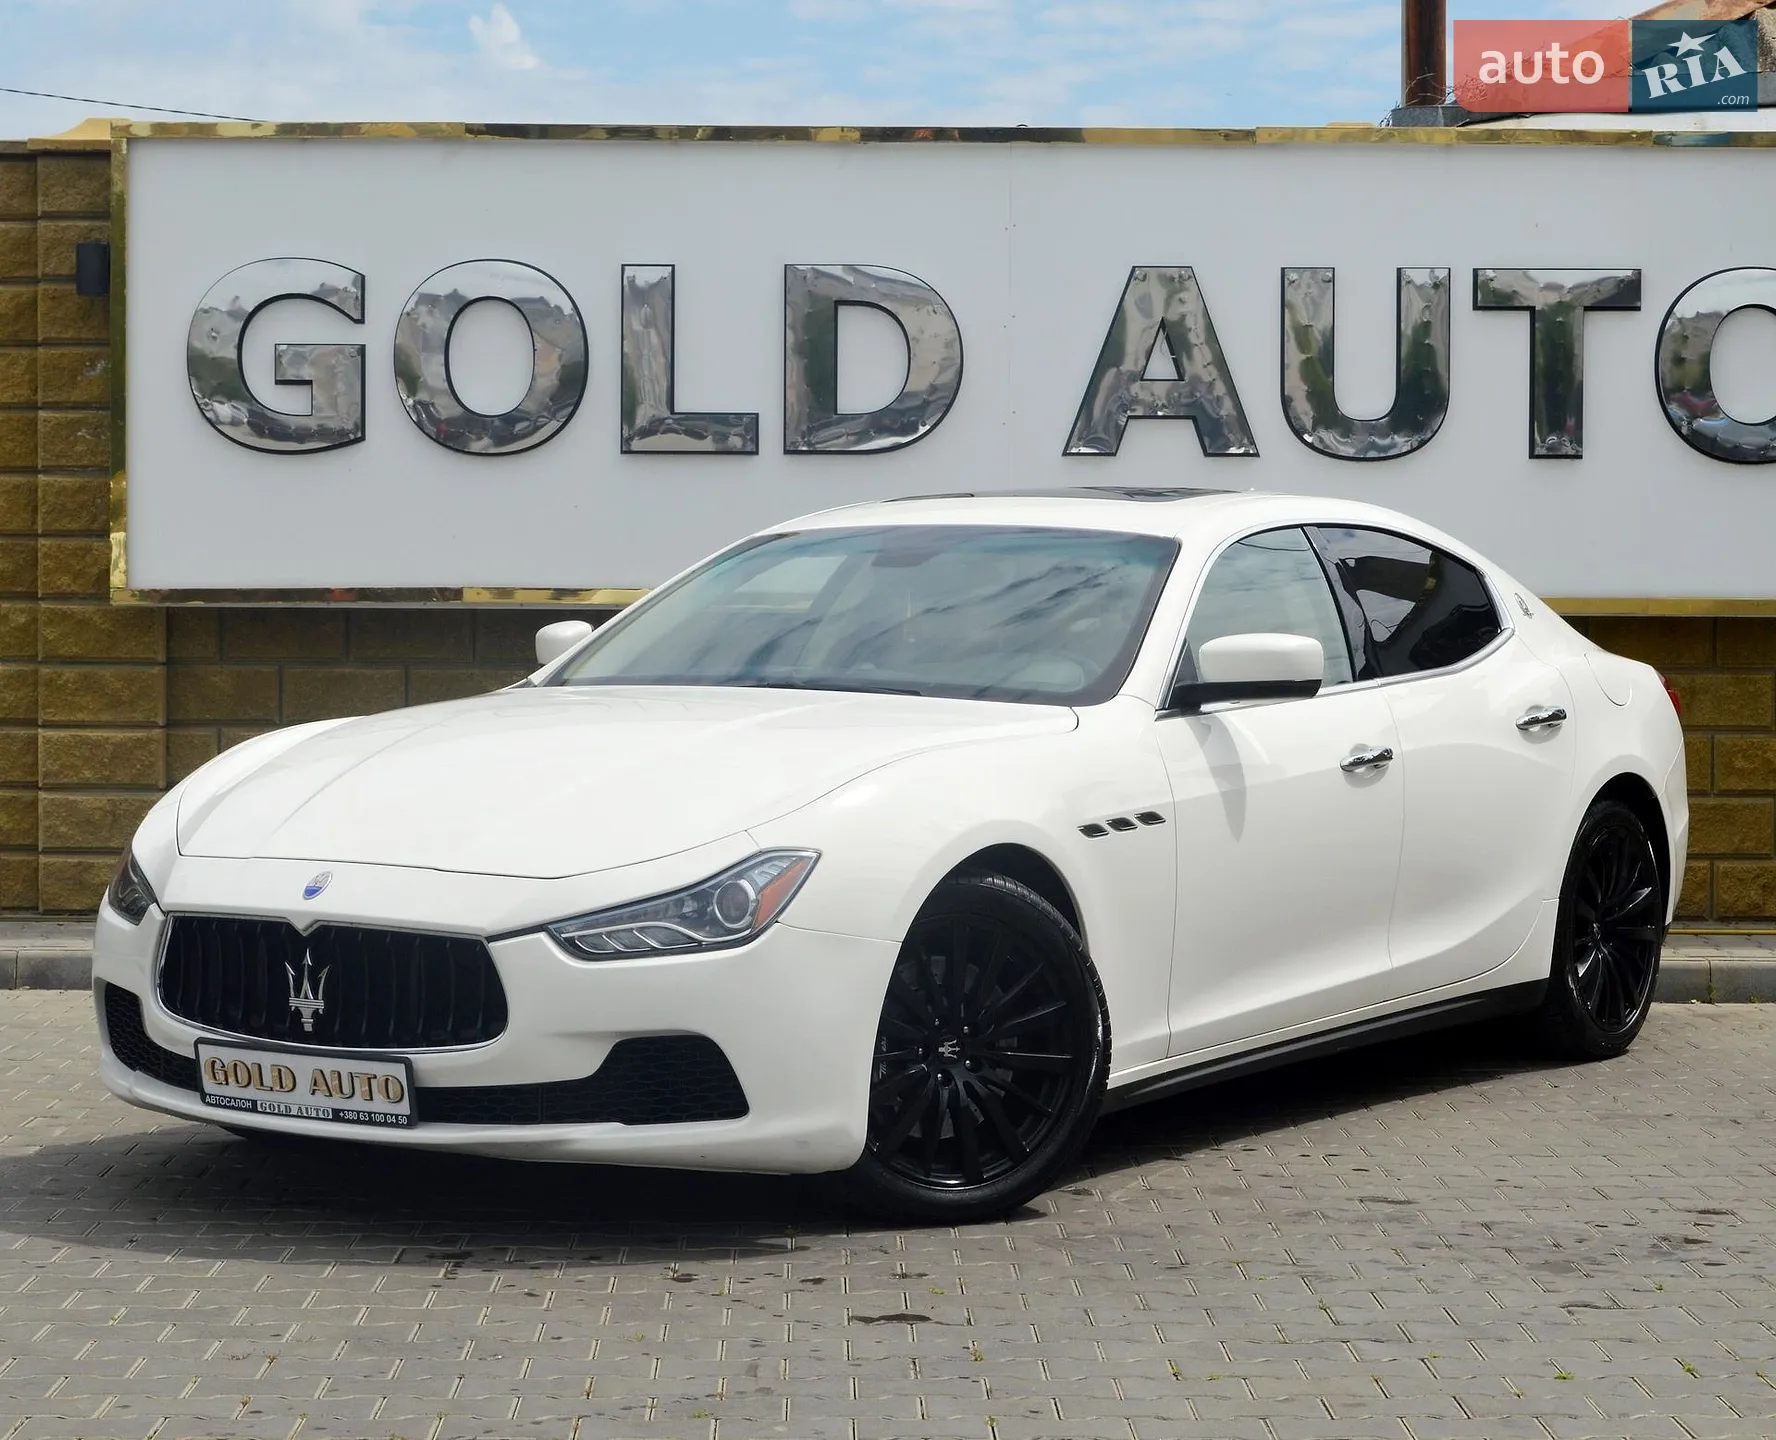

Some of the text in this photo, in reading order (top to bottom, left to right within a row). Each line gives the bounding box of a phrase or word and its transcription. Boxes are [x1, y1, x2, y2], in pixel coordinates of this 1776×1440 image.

[187, 257, 1776, 464] GOLD AUTO
[204, 1057, 404, 1103] GOLD AUTO
[205, 1095, 408, 1125] АВТОСАЛОН GOLD AUTO +380 63 100 04 50
